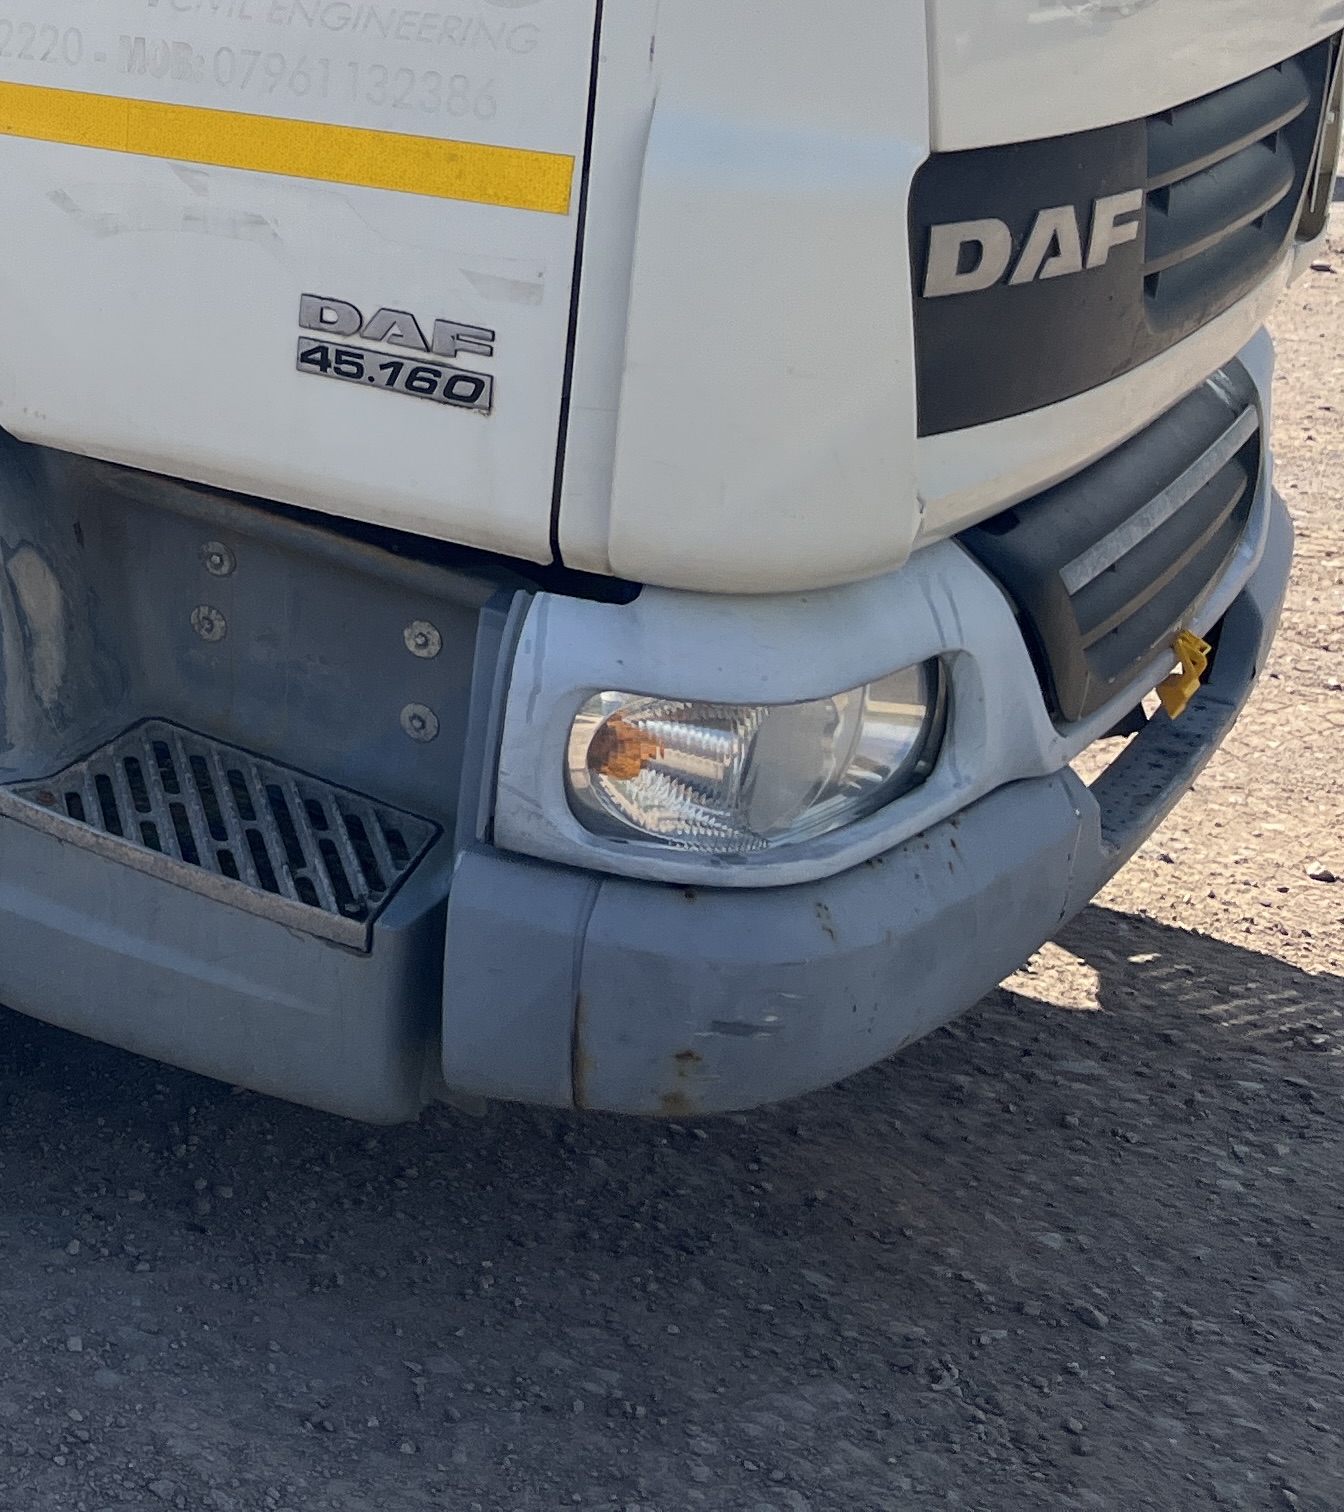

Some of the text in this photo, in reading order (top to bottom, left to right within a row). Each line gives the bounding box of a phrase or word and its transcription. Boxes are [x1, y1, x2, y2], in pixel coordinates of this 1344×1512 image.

[922, 187, 1144, 299] DAF
[298, 292, 495, 358] DAF
[299, 344, 486, 404] 45.160
